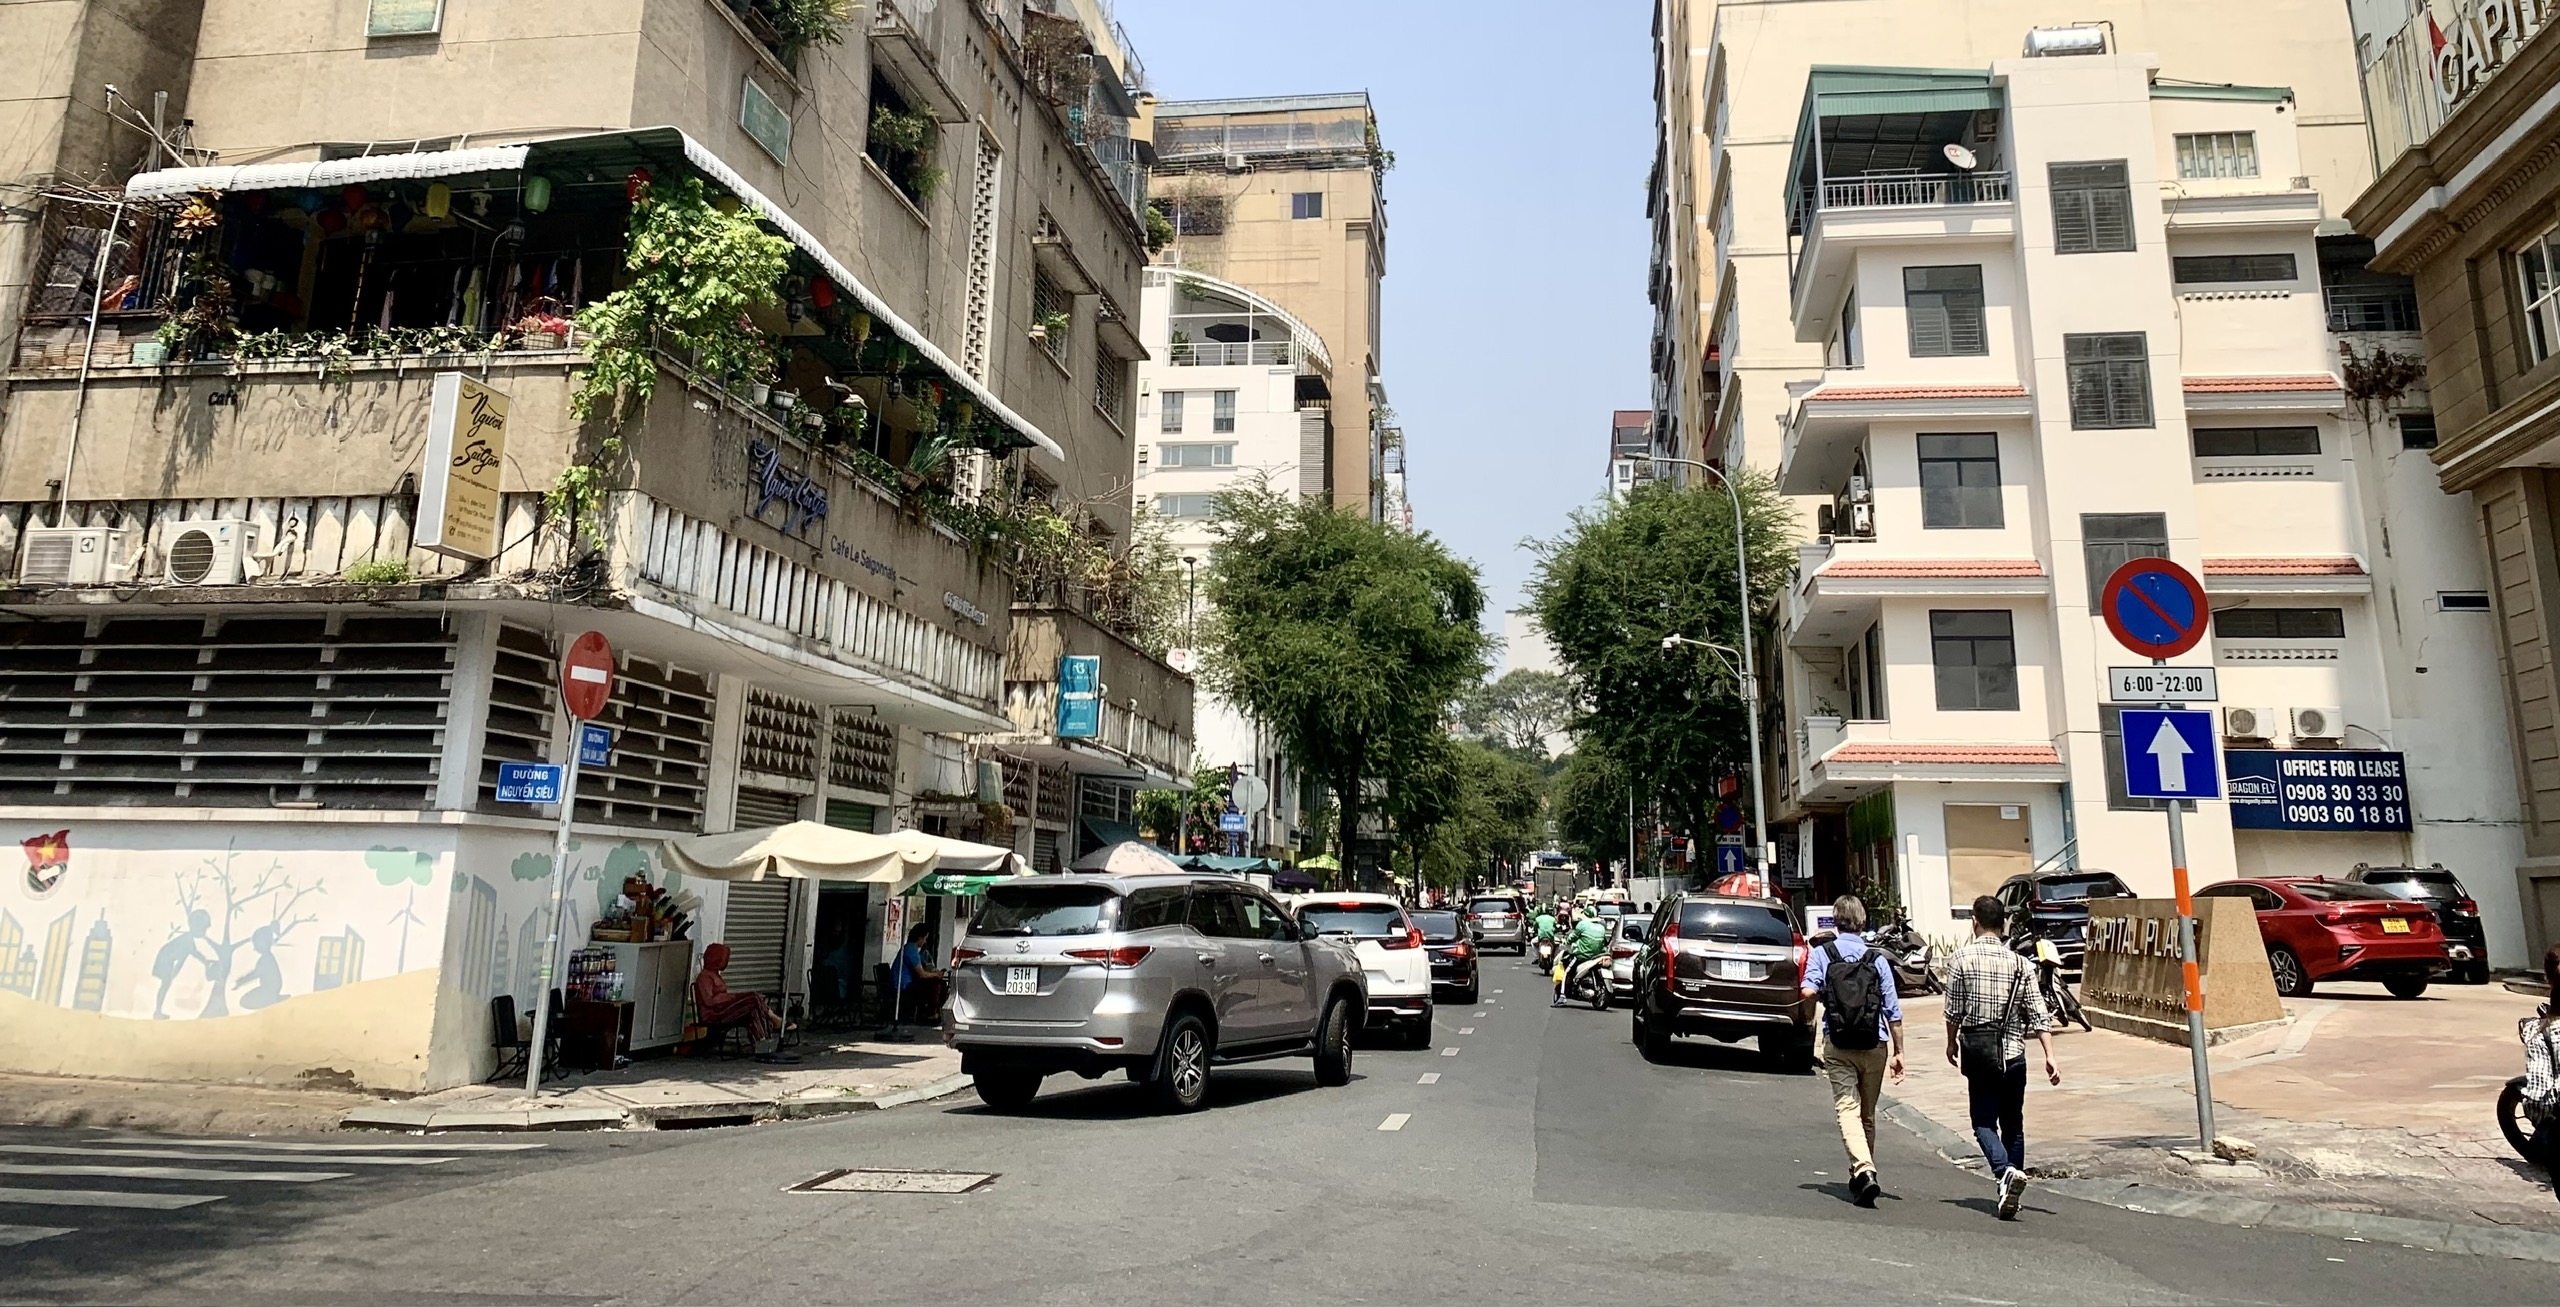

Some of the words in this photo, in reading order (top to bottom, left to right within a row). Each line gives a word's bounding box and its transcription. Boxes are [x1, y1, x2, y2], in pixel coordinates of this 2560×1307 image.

[850, 544, 860, 564] Le
[512, 769, 549, 780] ĐƯỜNG
[2282, 759, 2328, 777] OFFICE
[2330, 760, 2356, 777] FOR
[2359, 760, 2400, 778] LEASE
[2261, 782, 2276, 794] FLY
[2285, 784, 2327, 801] 0908
[2331, 784, 2352, 801] 30
[2356, 785, 2377, 801] 33
[2382, 785, 2403, 802] 30
[2288, 805, 2330, 822] 0903
[2333, 805, 2354, 823] 60
[2359, 806, 2380, 823] 18
[2385, 806, 2404, 823] 81
[2086, 916, 2140, 955] CAPITAL
[1013, 968, 1031, 980] 51H
[1006, 981, 1036, 994] 203.90
